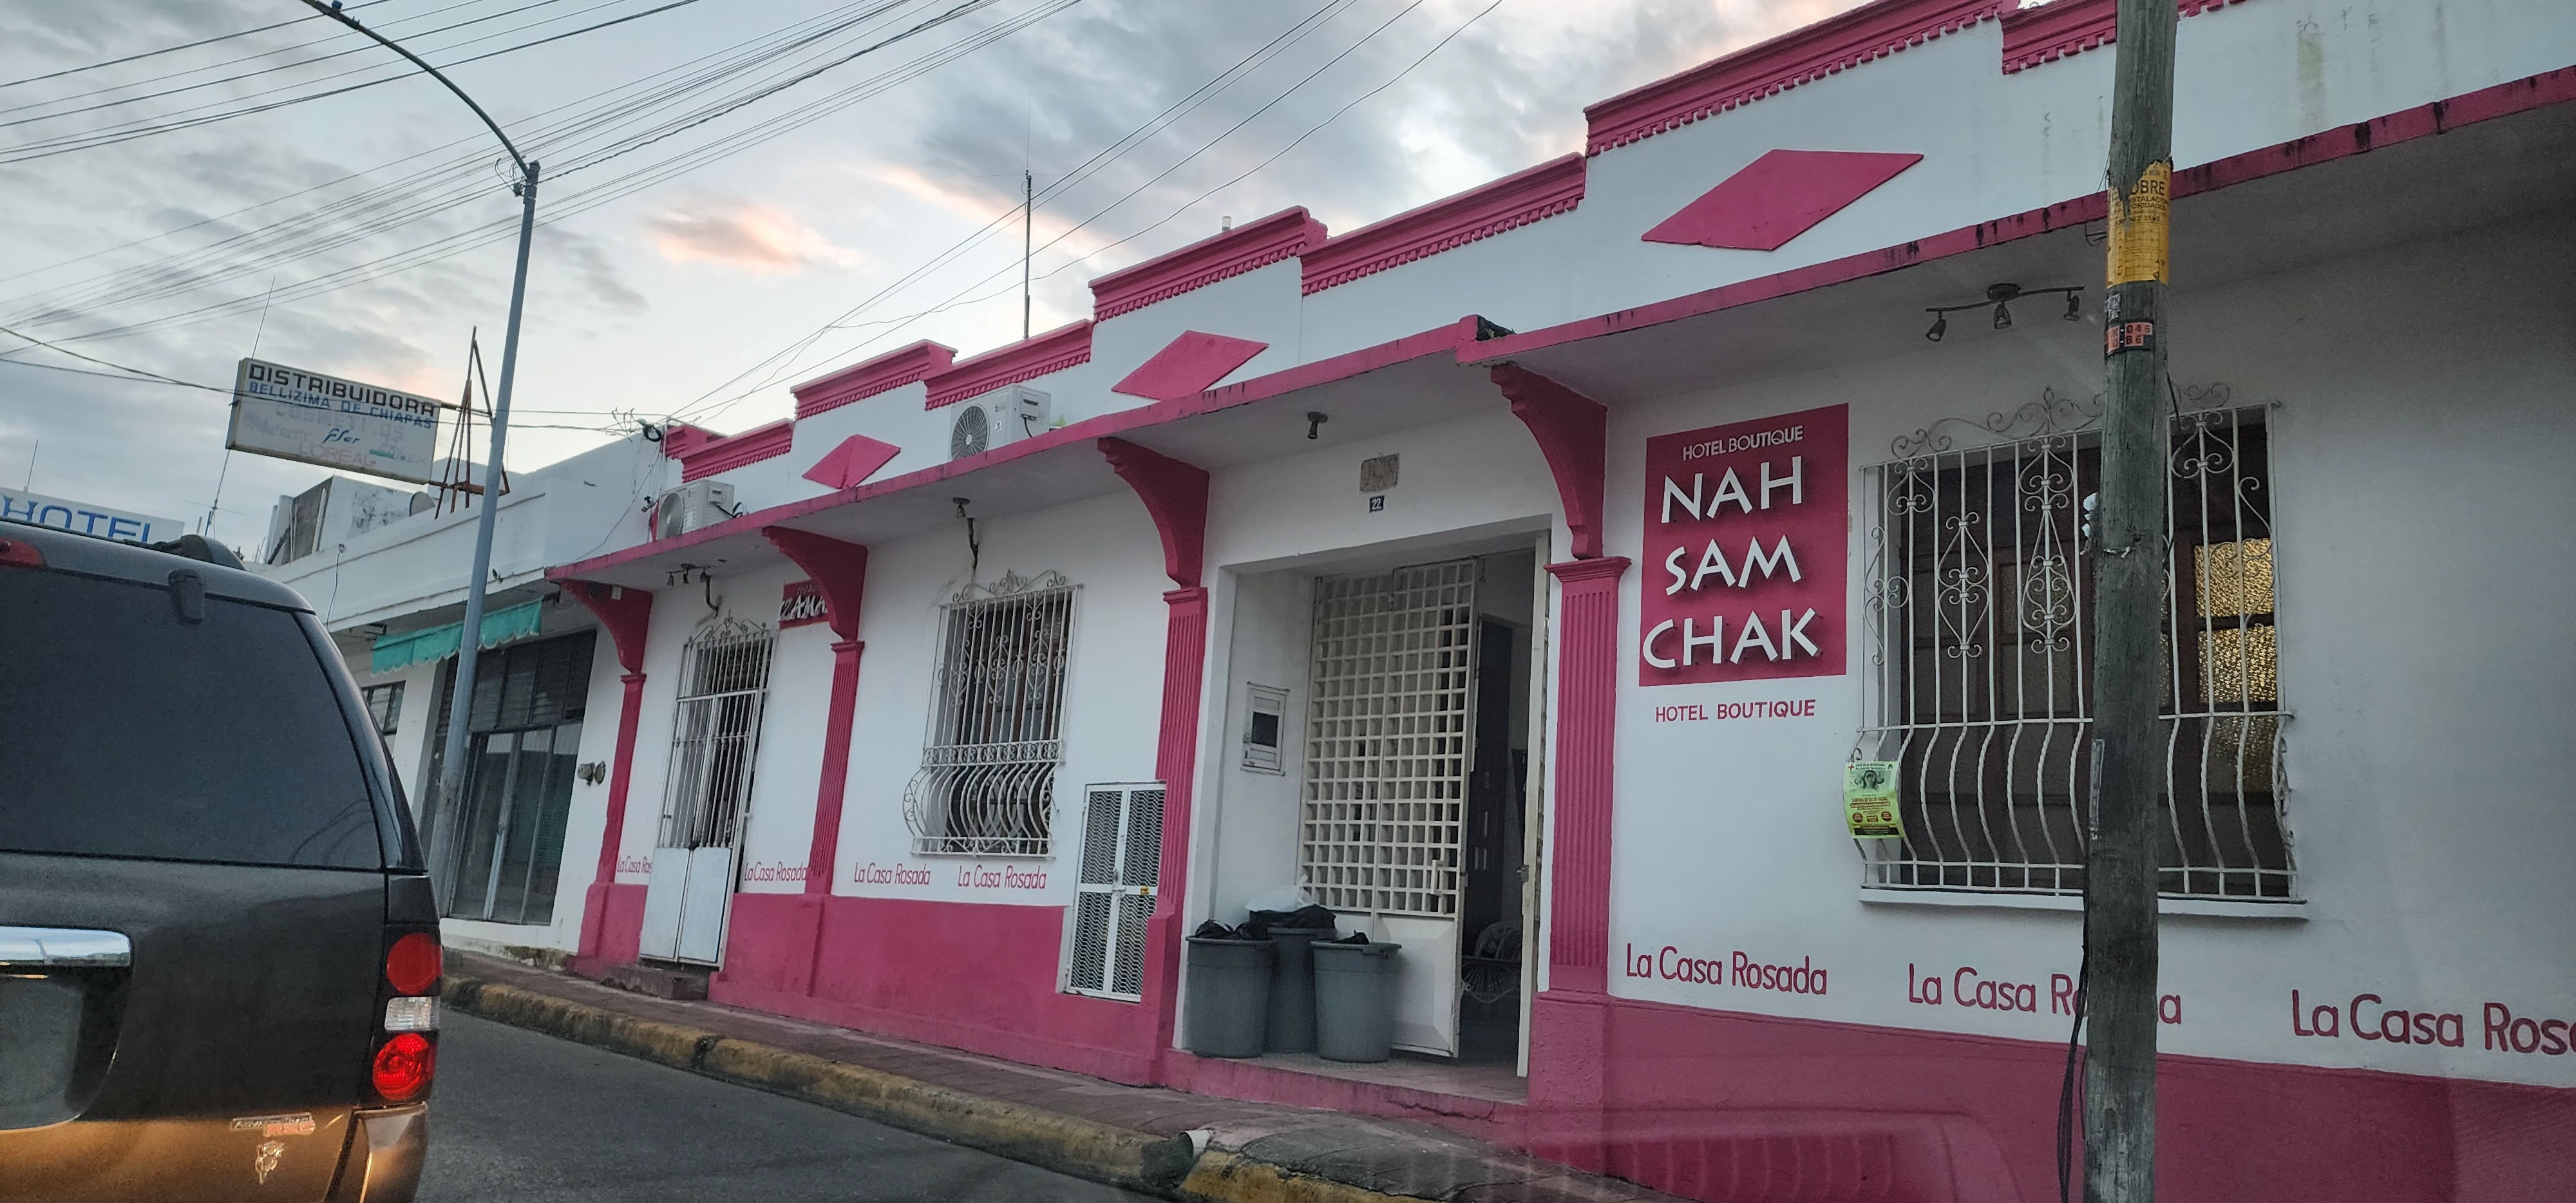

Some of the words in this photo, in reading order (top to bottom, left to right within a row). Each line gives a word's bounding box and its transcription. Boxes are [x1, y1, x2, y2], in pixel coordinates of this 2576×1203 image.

[249, 363, 435, 417] DISTRIBUIDORA
[249, 381, 331, 408] BELLIZIMA
[341, 400, 361, 413] DE
[370, 406, 431, 429] CHIAPAS
[1682, 438, 1726, 461] HOTEL
[1728, 425, 1804, 453] BOUTIQUE
[1372, 497, 1382, 509] 22
[1661, 455, 1803, 524] NAH
[1665, 534, 1802, 596] SAM
[1642, 607, 1819, 668] CHAK
[1654, 704, 1709, 723] HOTEL
[1717, 699, 1817, 720] BOUTIQUE
[625, 855, 640, 873] Casa
[744, 862, 753, 882] La
[753, 861, 773, 882] Casa
[854, 862, 866, 884] La
[867, 862, 892, 884] Casa
[895, 863, 931, 886] Rosada
[958, 864, 969, 887] La
[974, 864, 1001, 888] Casa
[1004, 865, 1047, 890] Rosada
[1625, 942, 1652, 979] La
[1659, 946, 1723, 986] Casa
[1732, 951, 1828, 996] Rosada
[1908, 963, 1942, 1005] La
[1953, 967, 2036, 1014] Casa
[2291, 989, 2340, 1039] La
[2349, 993, 2465, 1048] Casa
[2483, 1001, 2576, 1056] Ros
